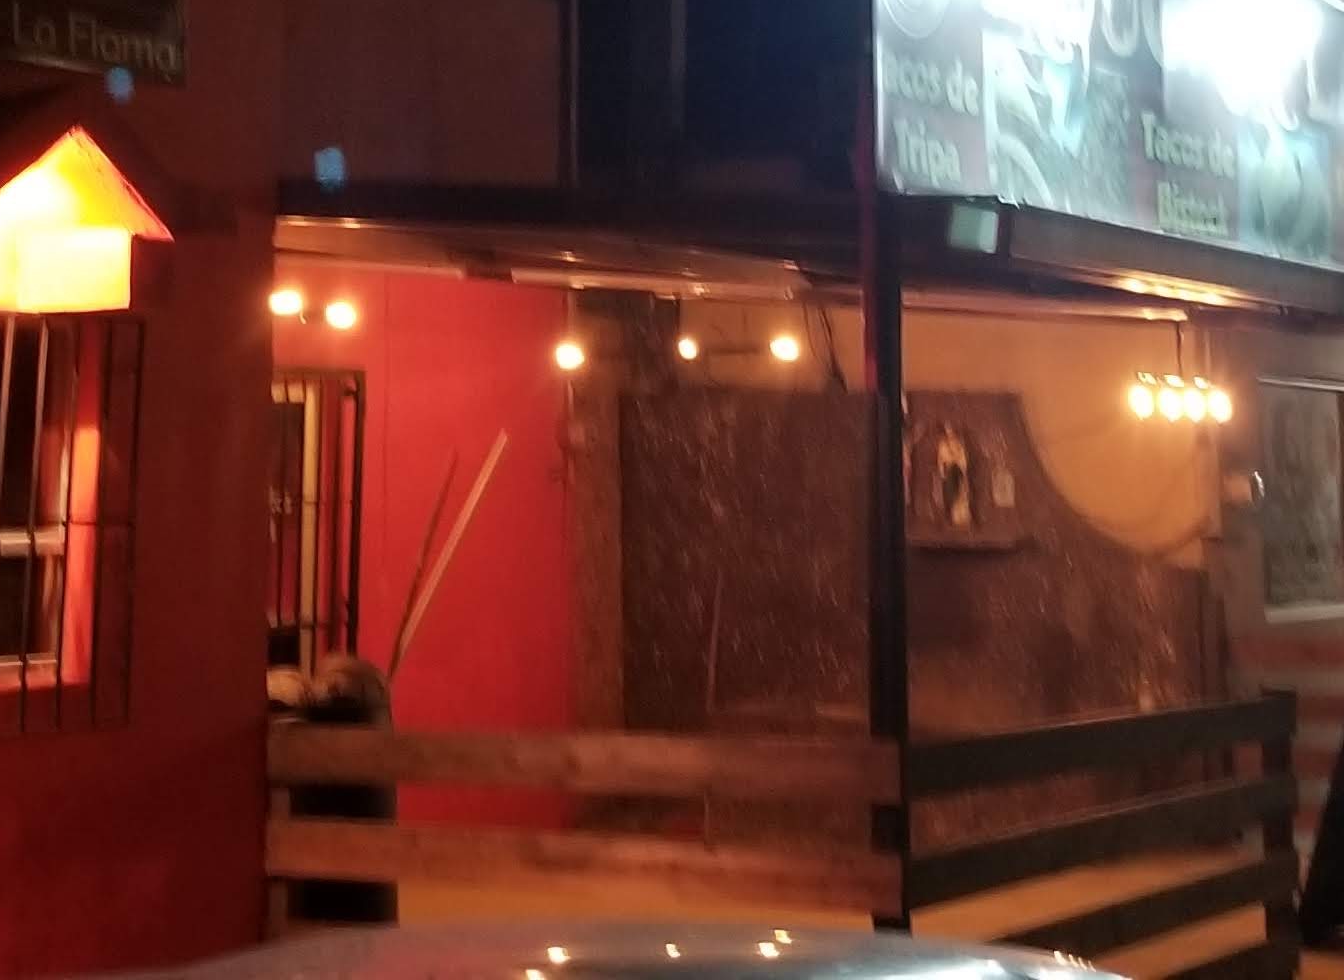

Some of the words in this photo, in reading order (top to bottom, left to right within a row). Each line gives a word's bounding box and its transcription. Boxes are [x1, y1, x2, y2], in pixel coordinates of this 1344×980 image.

[11, 0, 56, 48] La
[67, 10, 182, 76] Flama
[893, 117, 962, 188] Tripa
